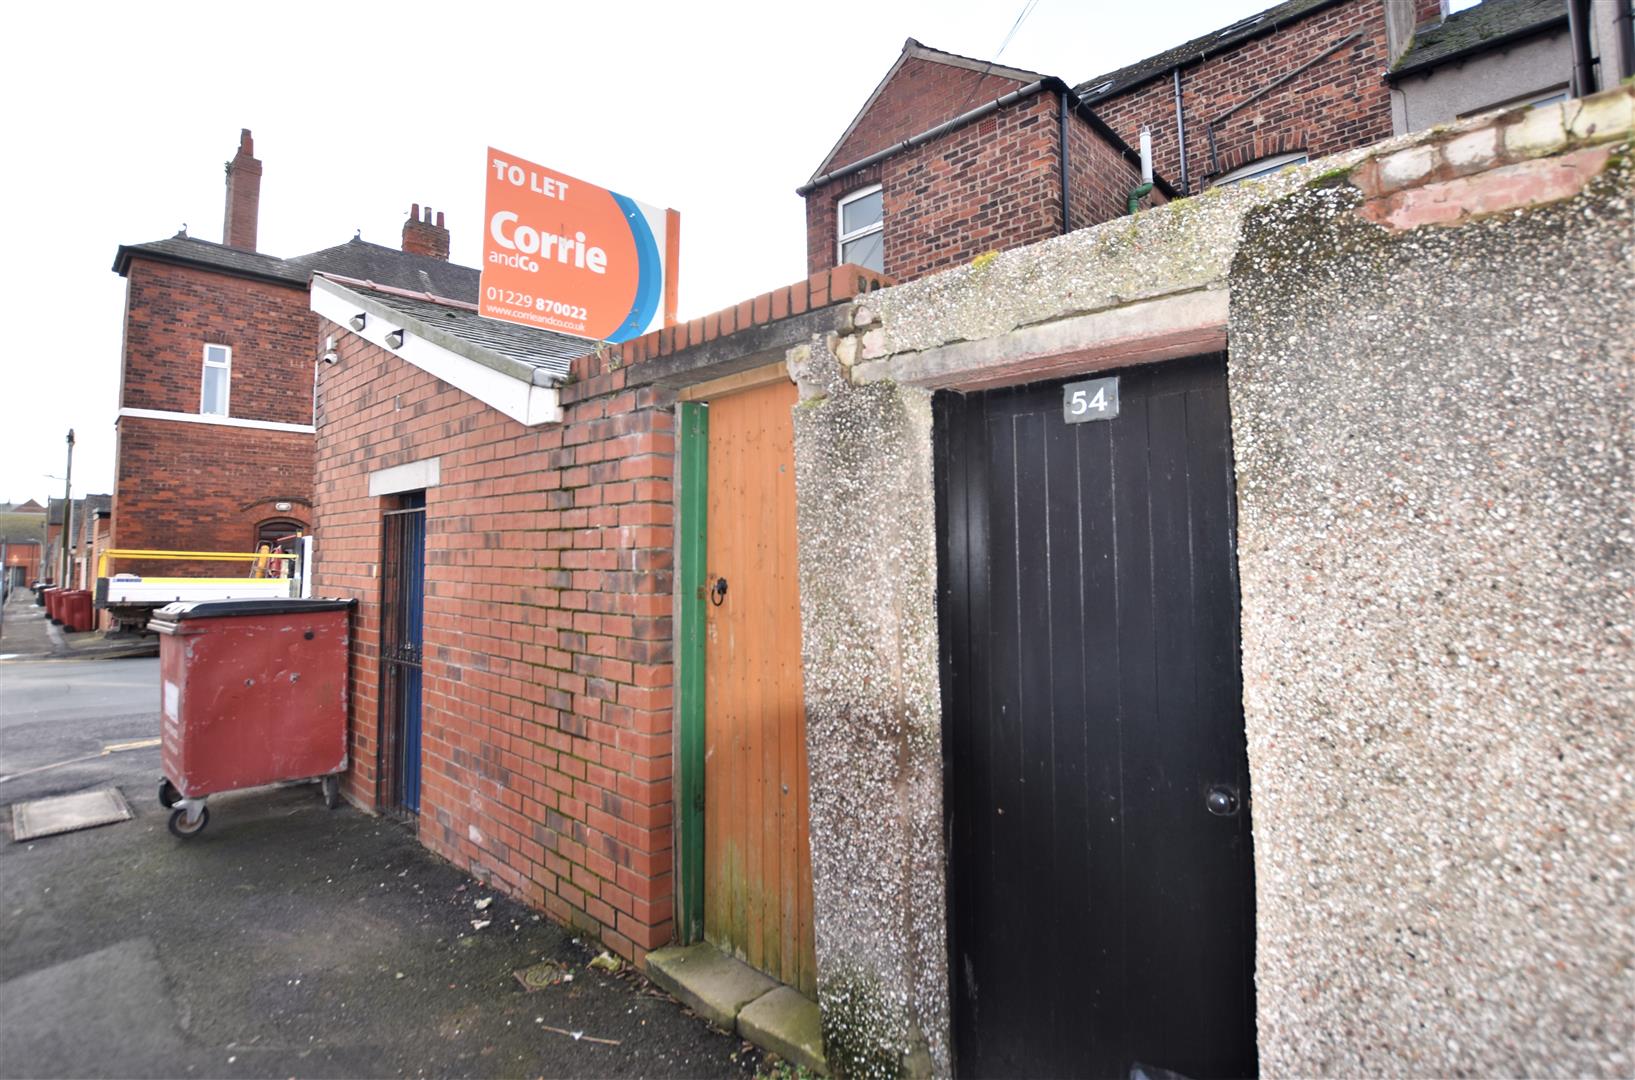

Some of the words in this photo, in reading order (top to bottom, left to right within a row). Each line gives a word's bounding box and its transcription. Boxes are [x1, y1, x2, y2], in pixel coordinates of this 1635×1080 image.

[492, 158, 526, 187] TO
[530, 171, 569, 201] LET
[490, 210, 608, 274] Corrie
[488, 250, 539, 273] andCo
[486, 286, 533, 308] 01229
[535, 297, 588, 321] 870022
[486, 304, 586, 332] www.corrieandco.co.uk
[1071, 387, 1108, 415] 54
